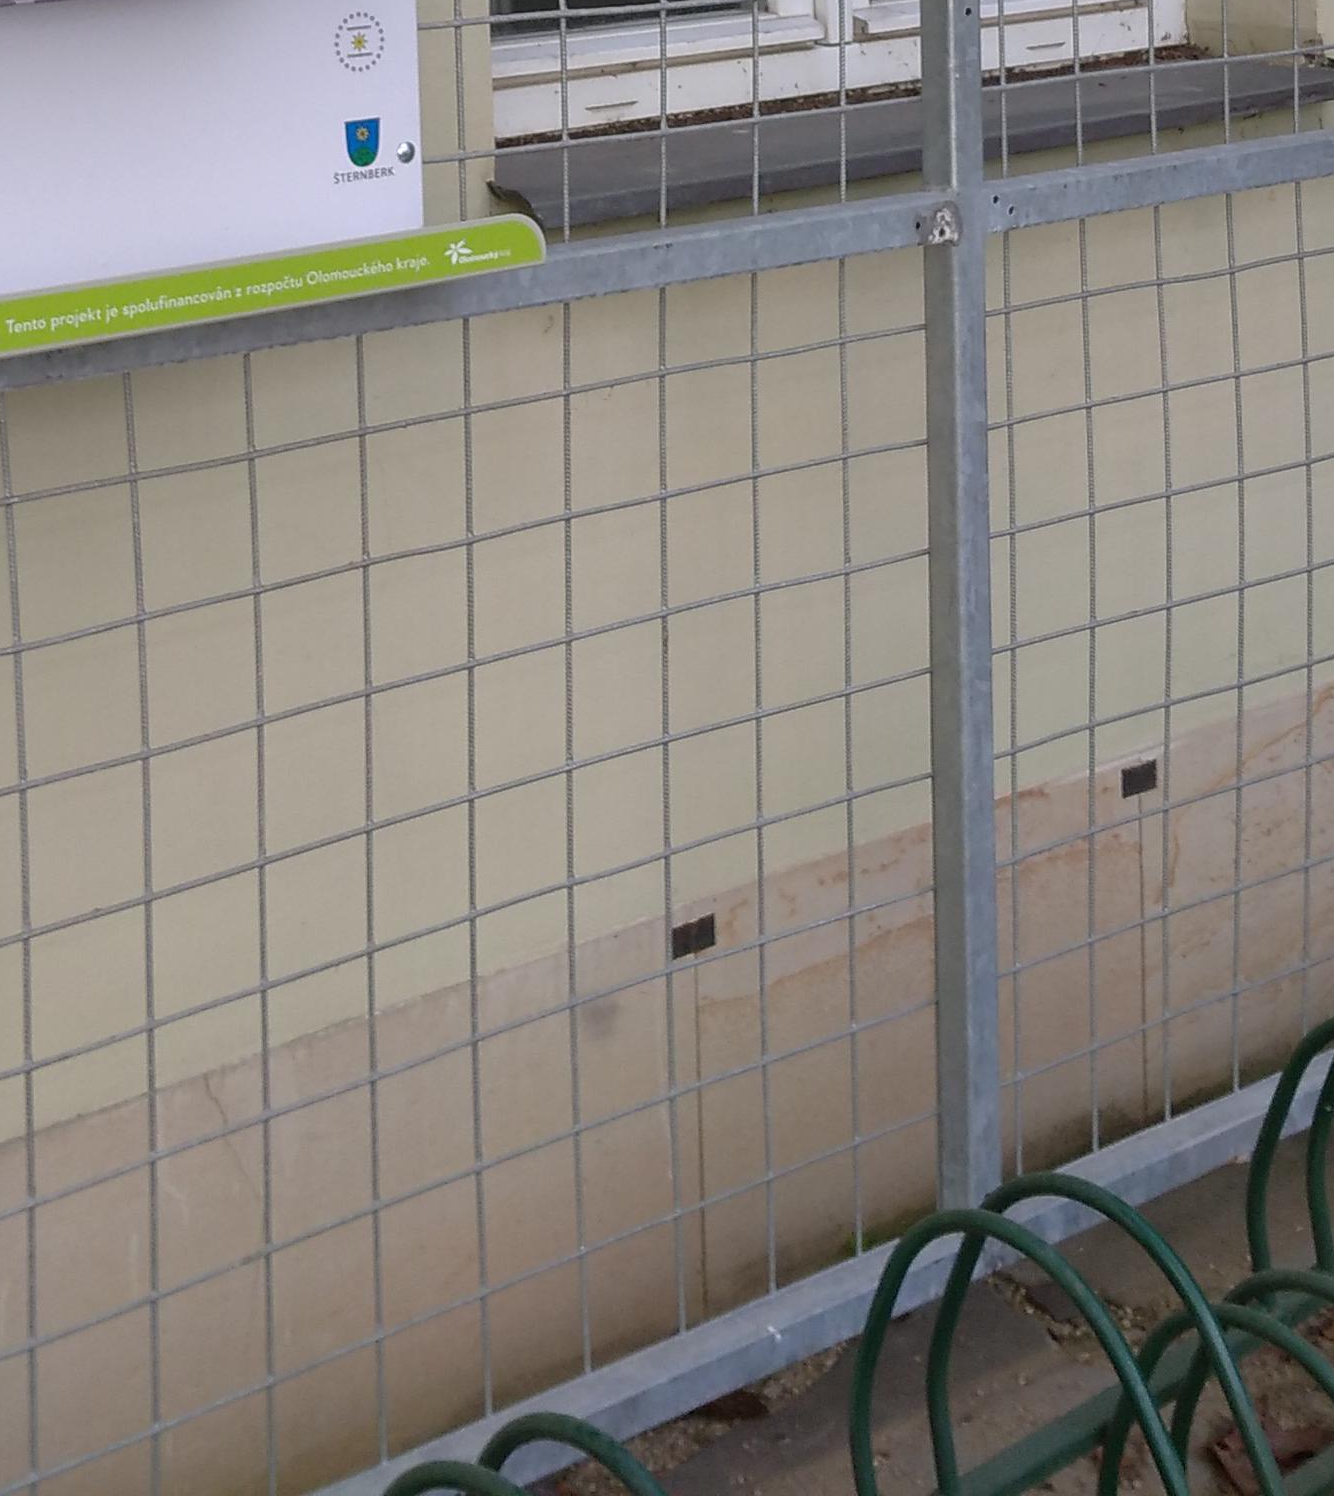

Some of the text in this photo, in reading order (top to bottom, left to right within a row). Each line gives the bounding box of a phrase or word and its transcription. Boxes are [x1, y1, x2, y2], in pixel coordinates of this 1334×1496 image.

[333, 166, 395, 185] ŠTERNBERK
[5, 255, 430, 334] Tento projekt je spolufinancován z rozpočtu Olomouckého kraje.
